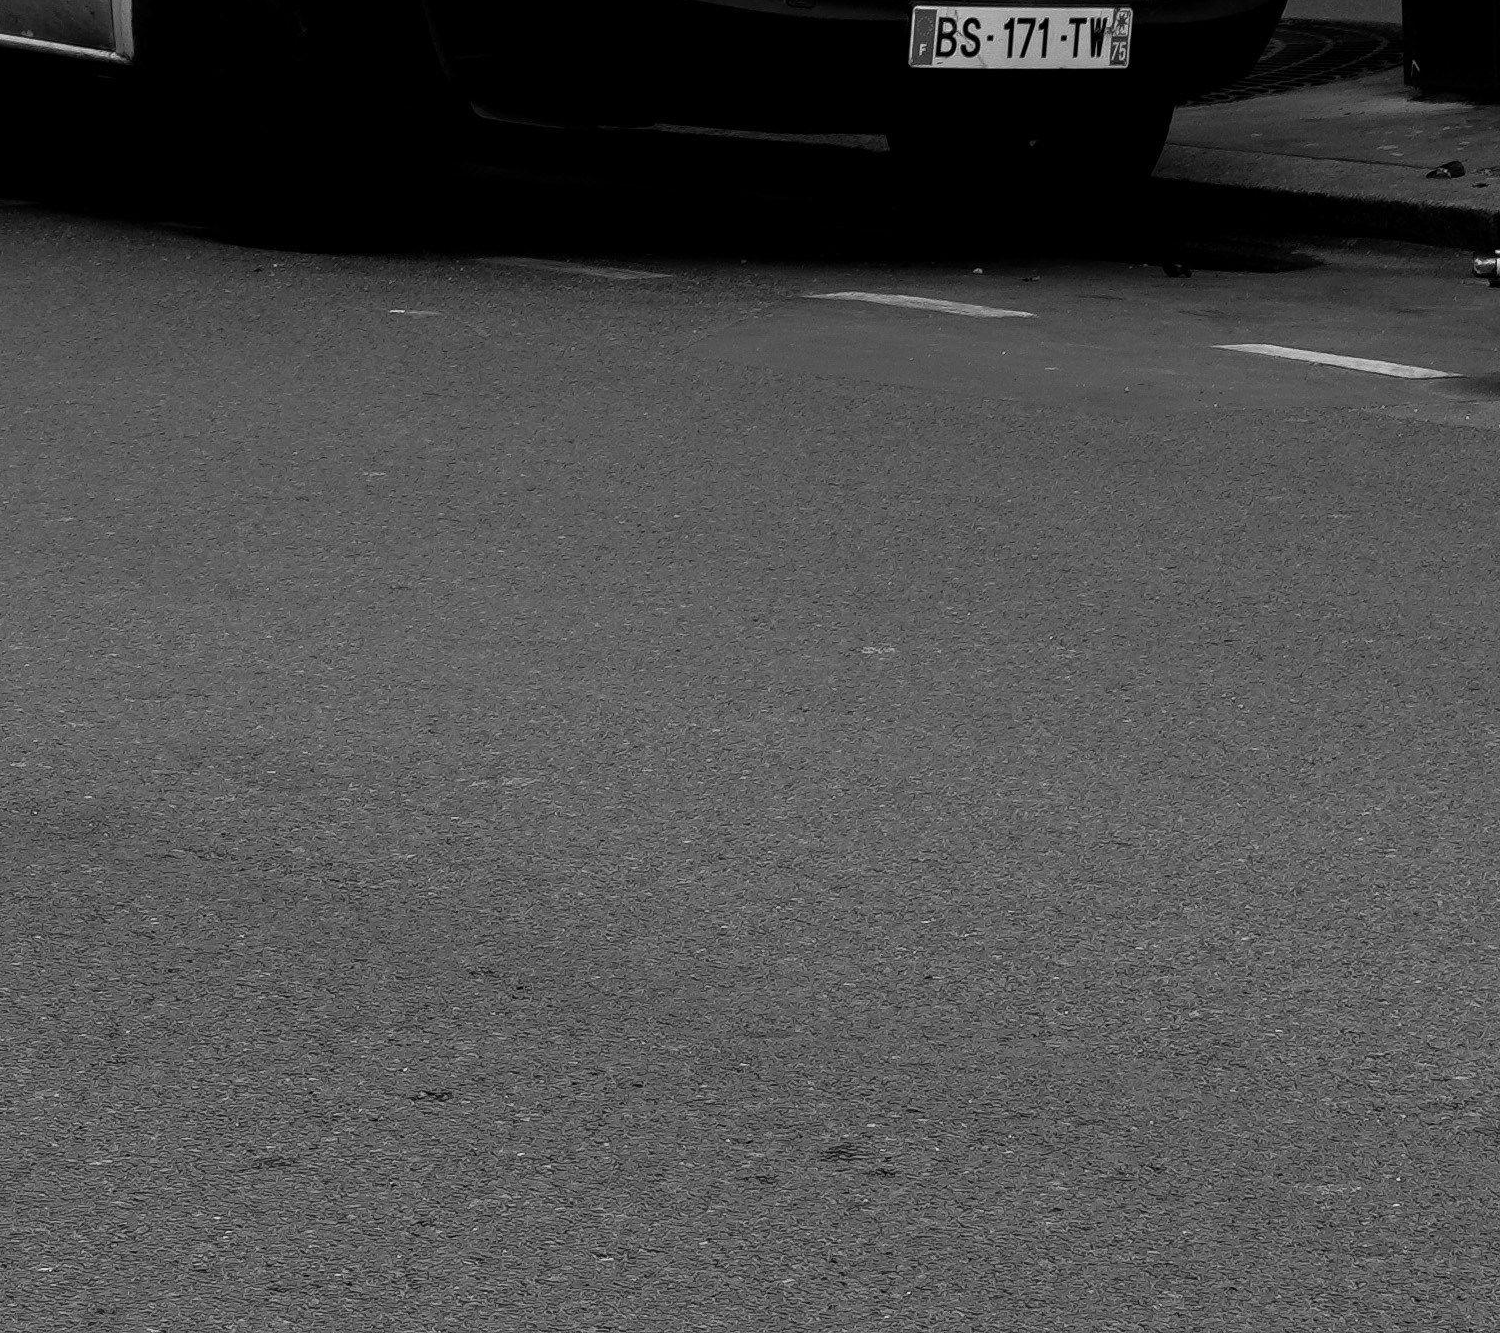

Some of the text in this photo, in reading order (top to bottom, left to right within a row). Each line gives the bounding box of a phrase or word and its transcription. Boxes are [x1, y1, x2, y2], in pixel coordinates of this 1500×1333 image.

[934, 17, 1108, 59] BS-171-TW
[918, 43, 927, 56] F
[1111, 41, 1127, 62] 75
